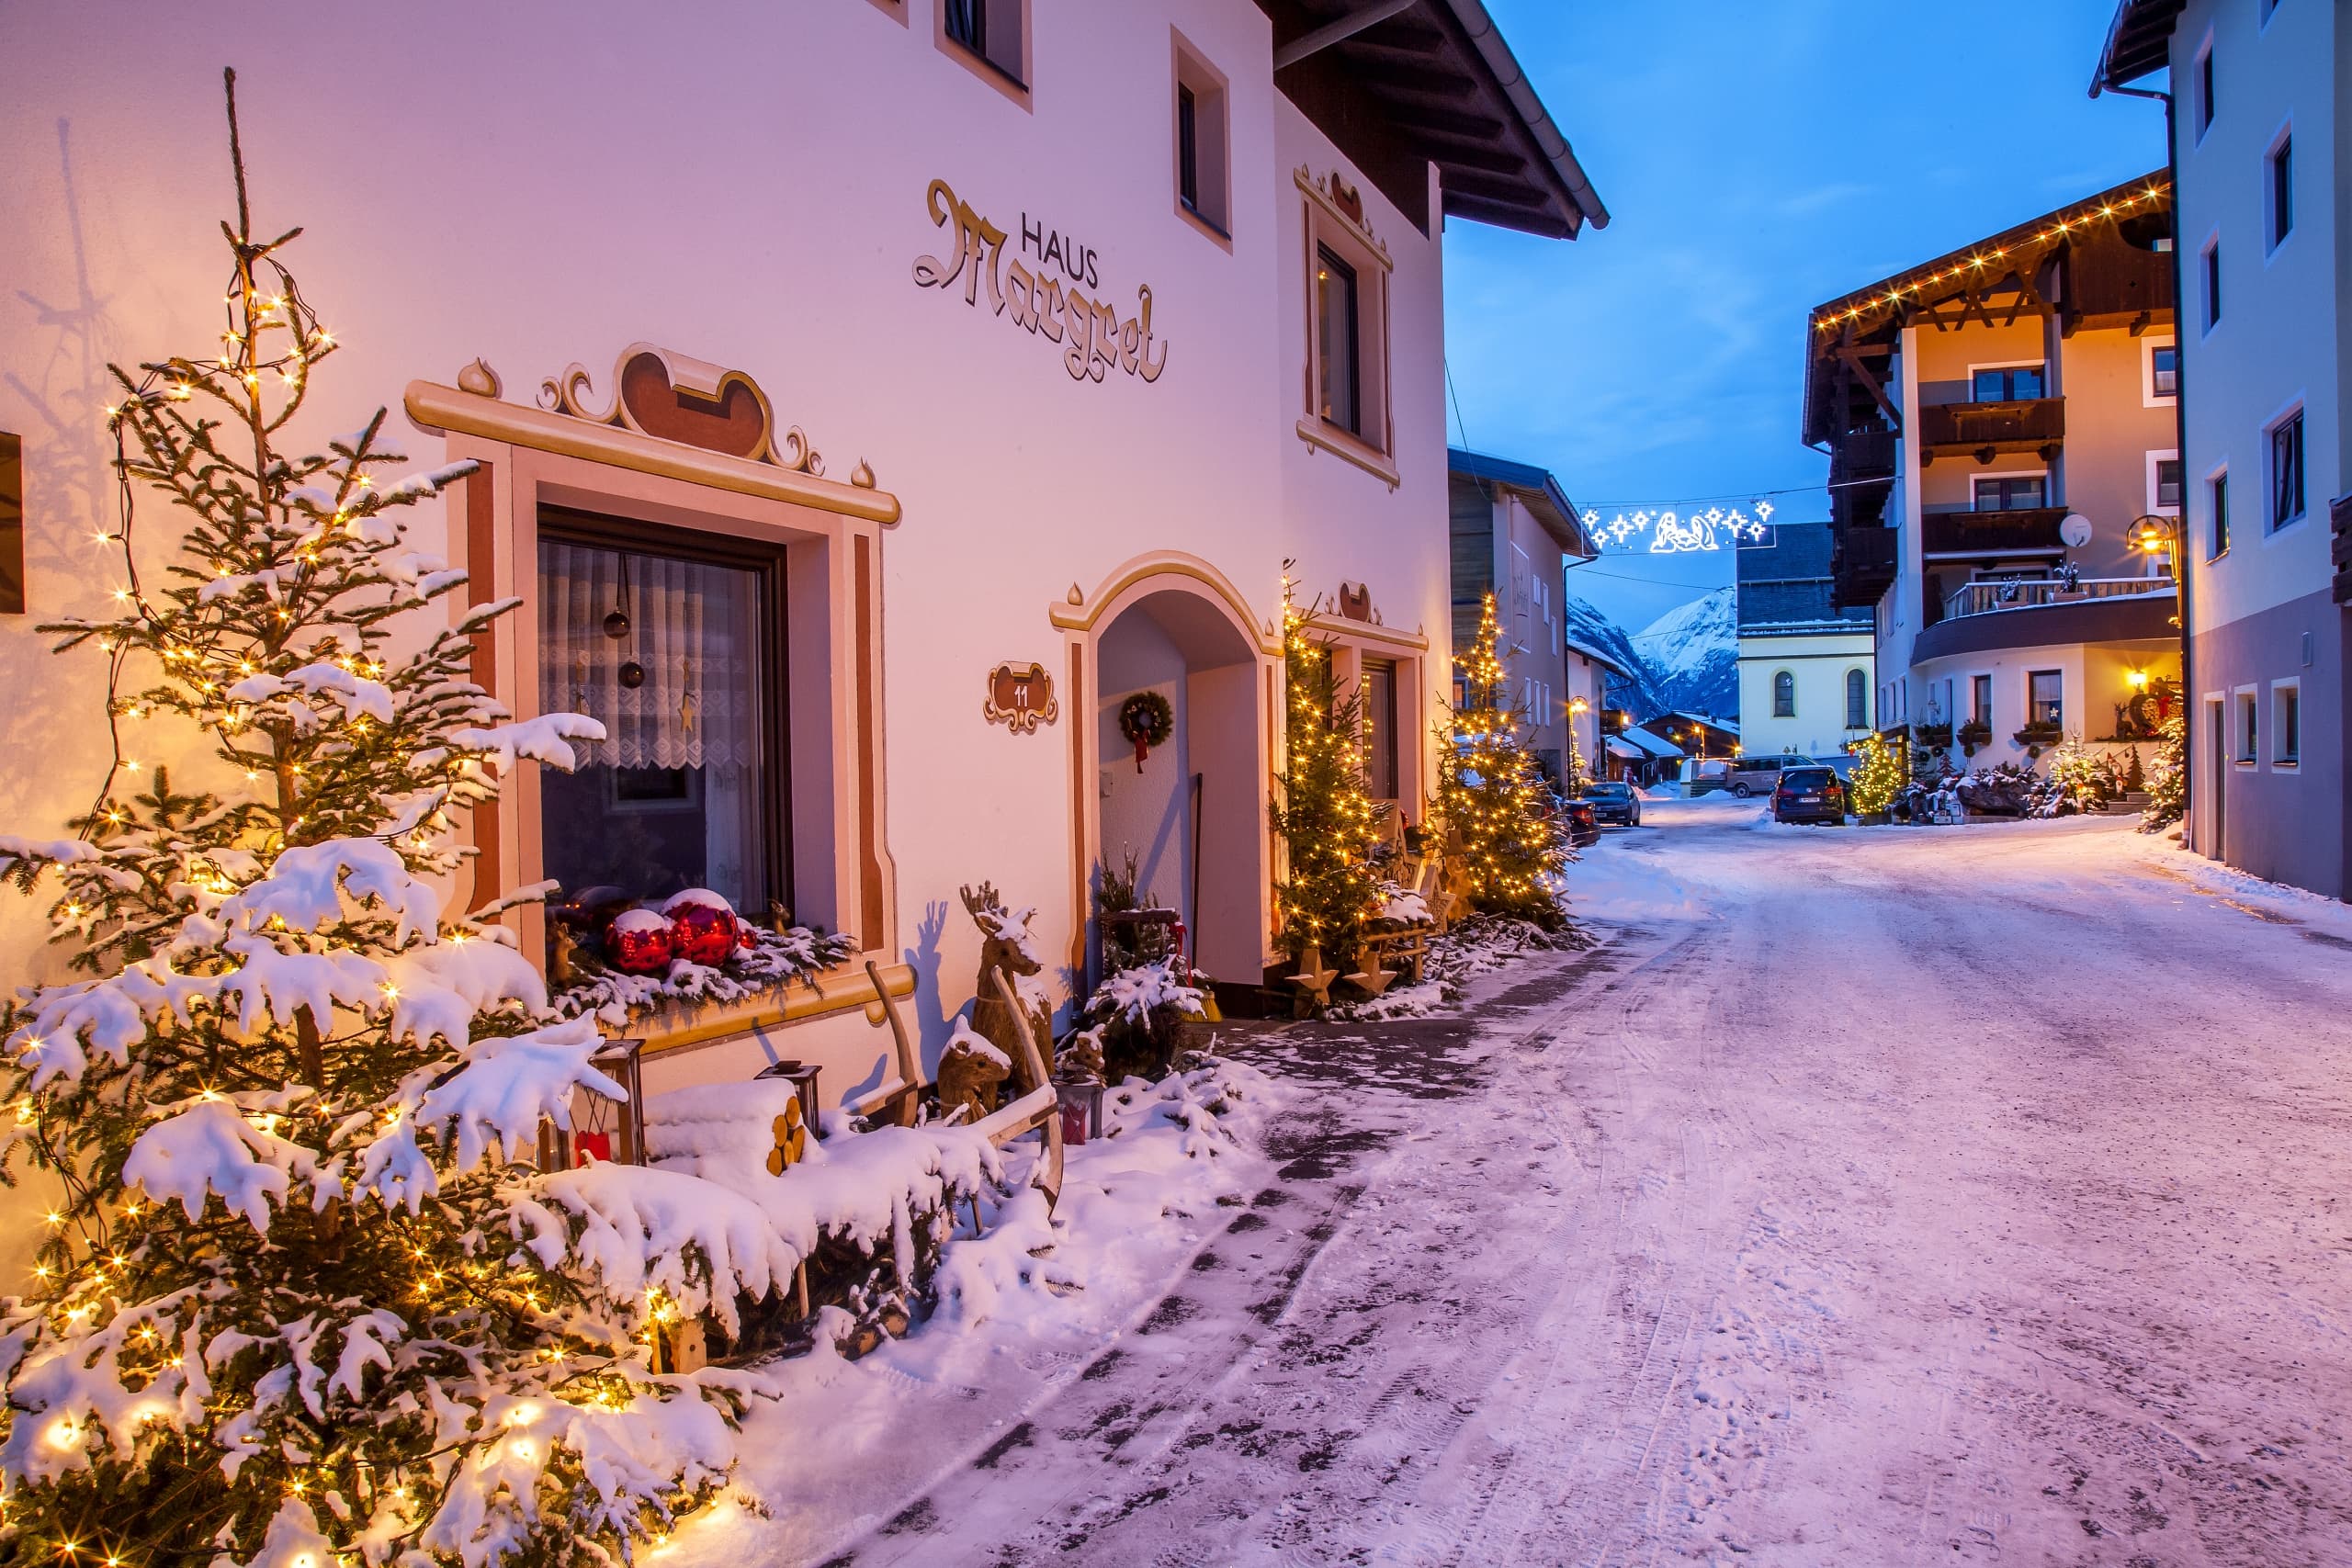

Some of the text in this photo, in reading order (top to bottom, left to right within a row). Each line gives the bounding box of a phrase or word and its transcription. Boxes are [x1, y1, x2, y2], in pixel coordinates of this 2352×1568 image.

[911, 178, 1168, 384] Margret
[1021, 211, 1098, 289] HAUS
[1013, 684, 1028, 707] 11
